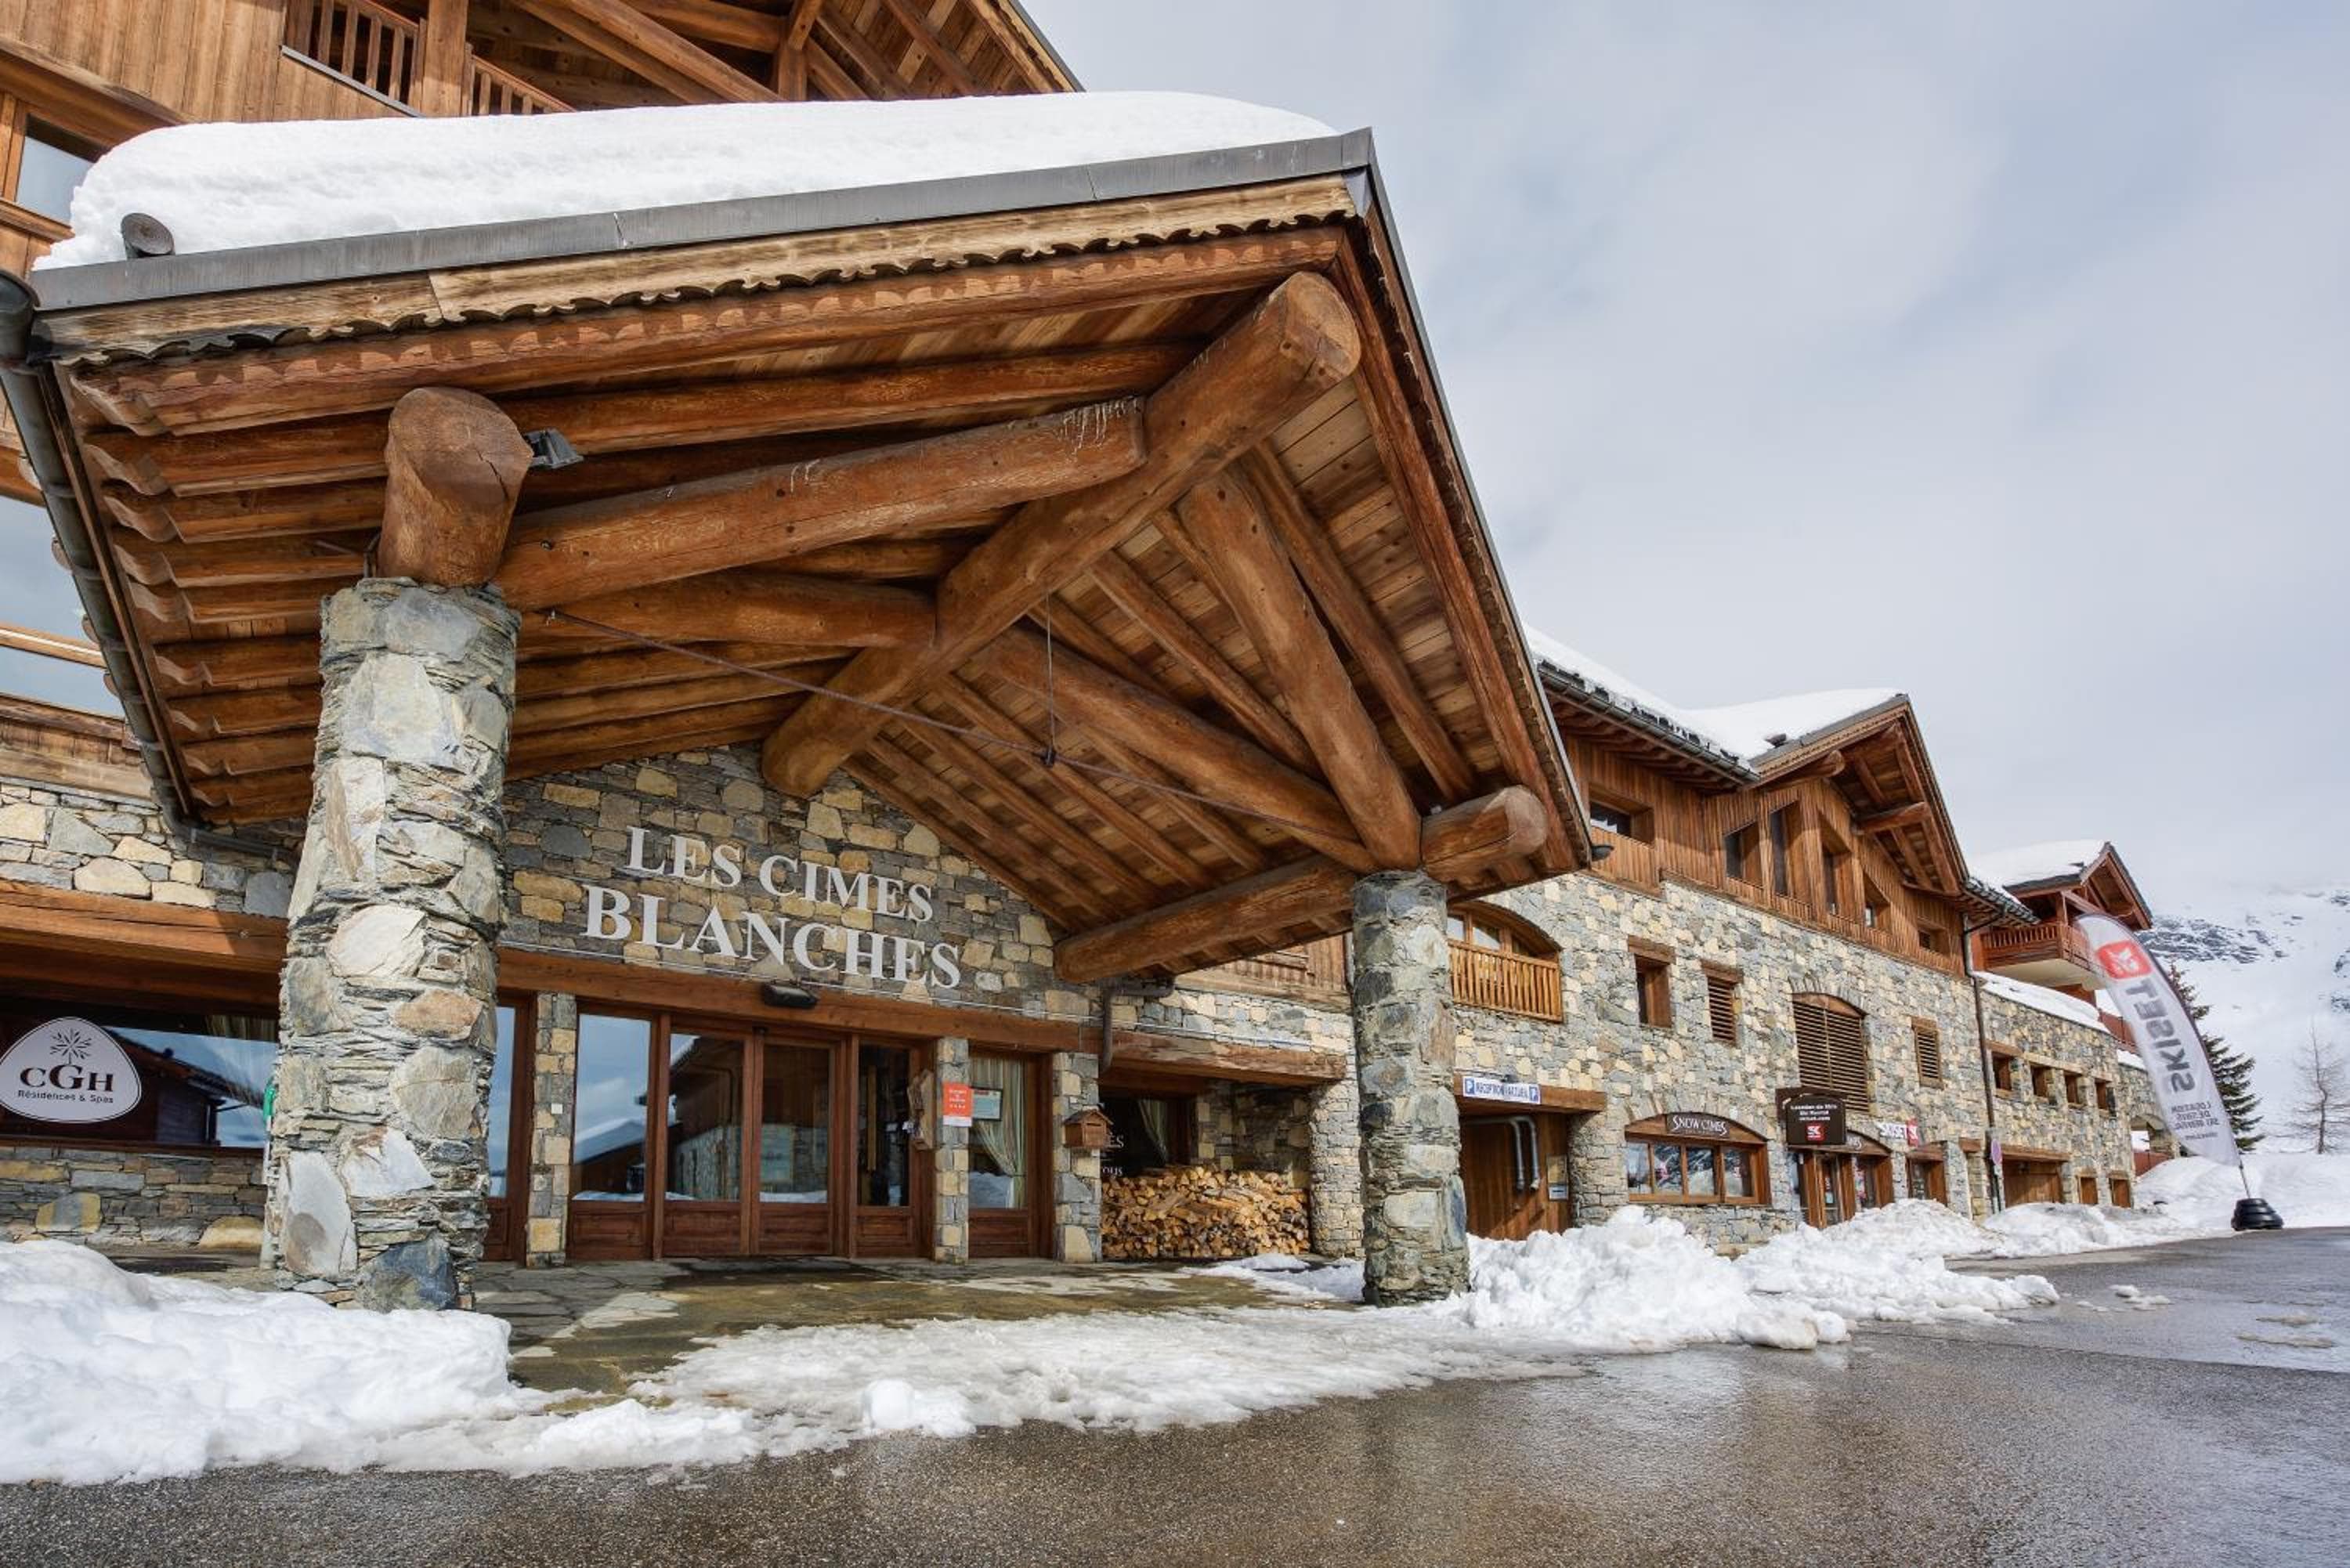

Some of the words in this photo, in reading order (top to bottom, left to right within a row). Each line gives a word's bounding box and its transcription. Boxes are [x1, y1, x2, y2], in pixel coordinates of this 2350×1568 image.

[626, 826, 742, 888] LES
[758, 854, 933, 923] CIMES
[580, 884, 961, 989] BLANCHES
[18, 1089, 76, 1101] Résidences
[89, 1095, 114, 1104] Spas
[20, 1064, 114, 1093] CGH
